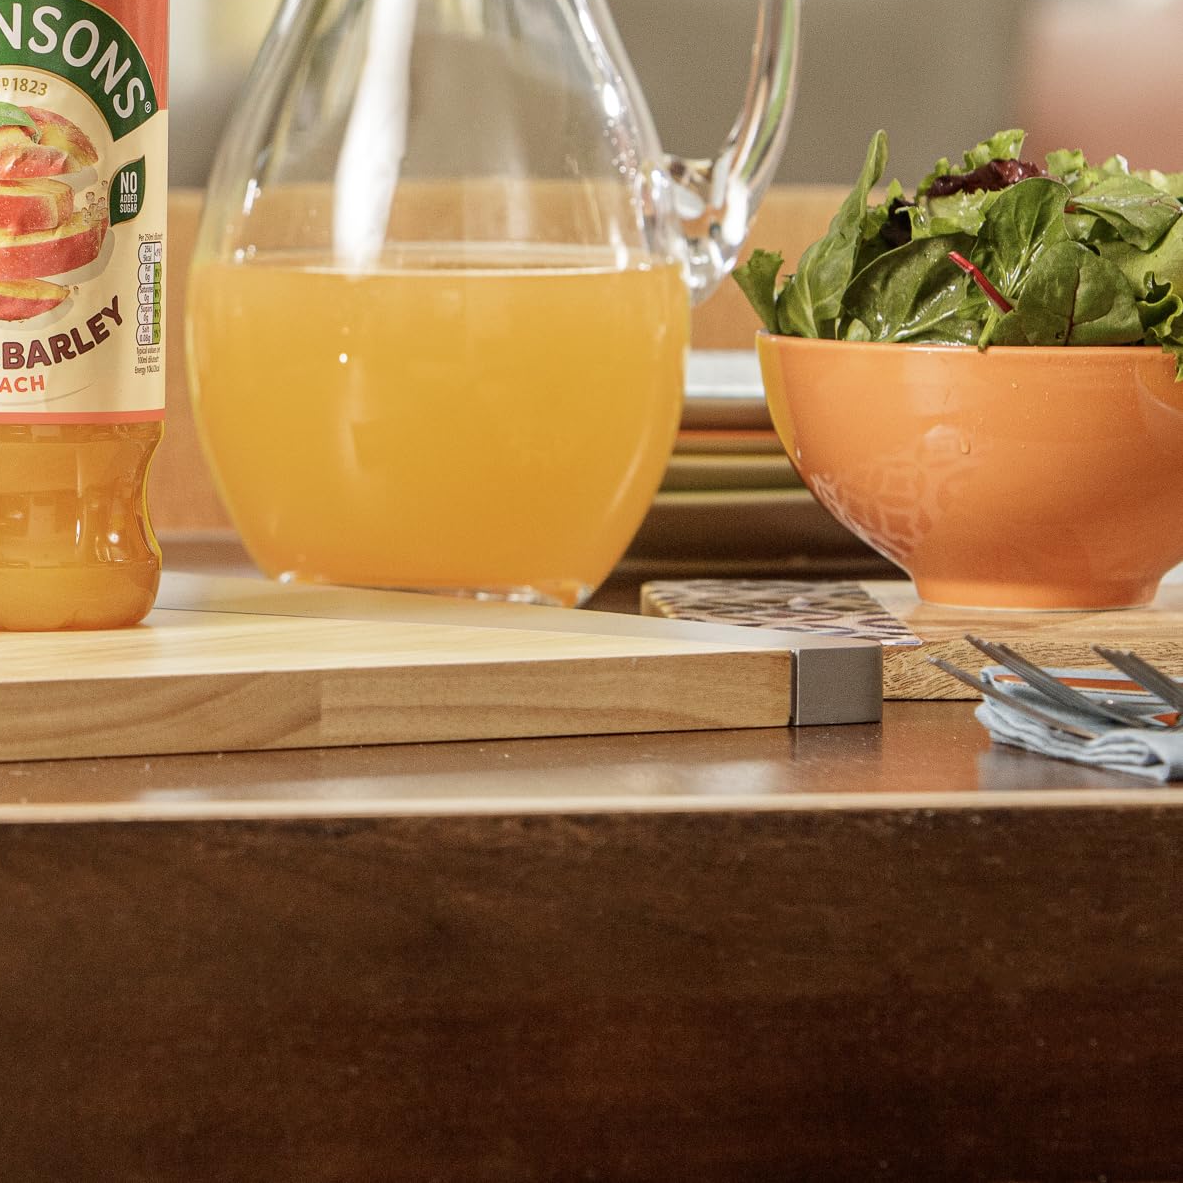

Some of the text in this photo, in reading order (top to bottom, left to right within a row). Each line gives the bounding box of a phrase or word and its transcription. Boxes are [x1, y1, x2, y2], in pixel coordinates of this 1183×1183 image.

[12, 77, 48, 96] 1823
[120, 171, 138, 194] NO
[120, 193, 138, 204] ADDED
[119, 203, 138, 214] SUGAR
[2, 294, 124, 370] BARLEY
